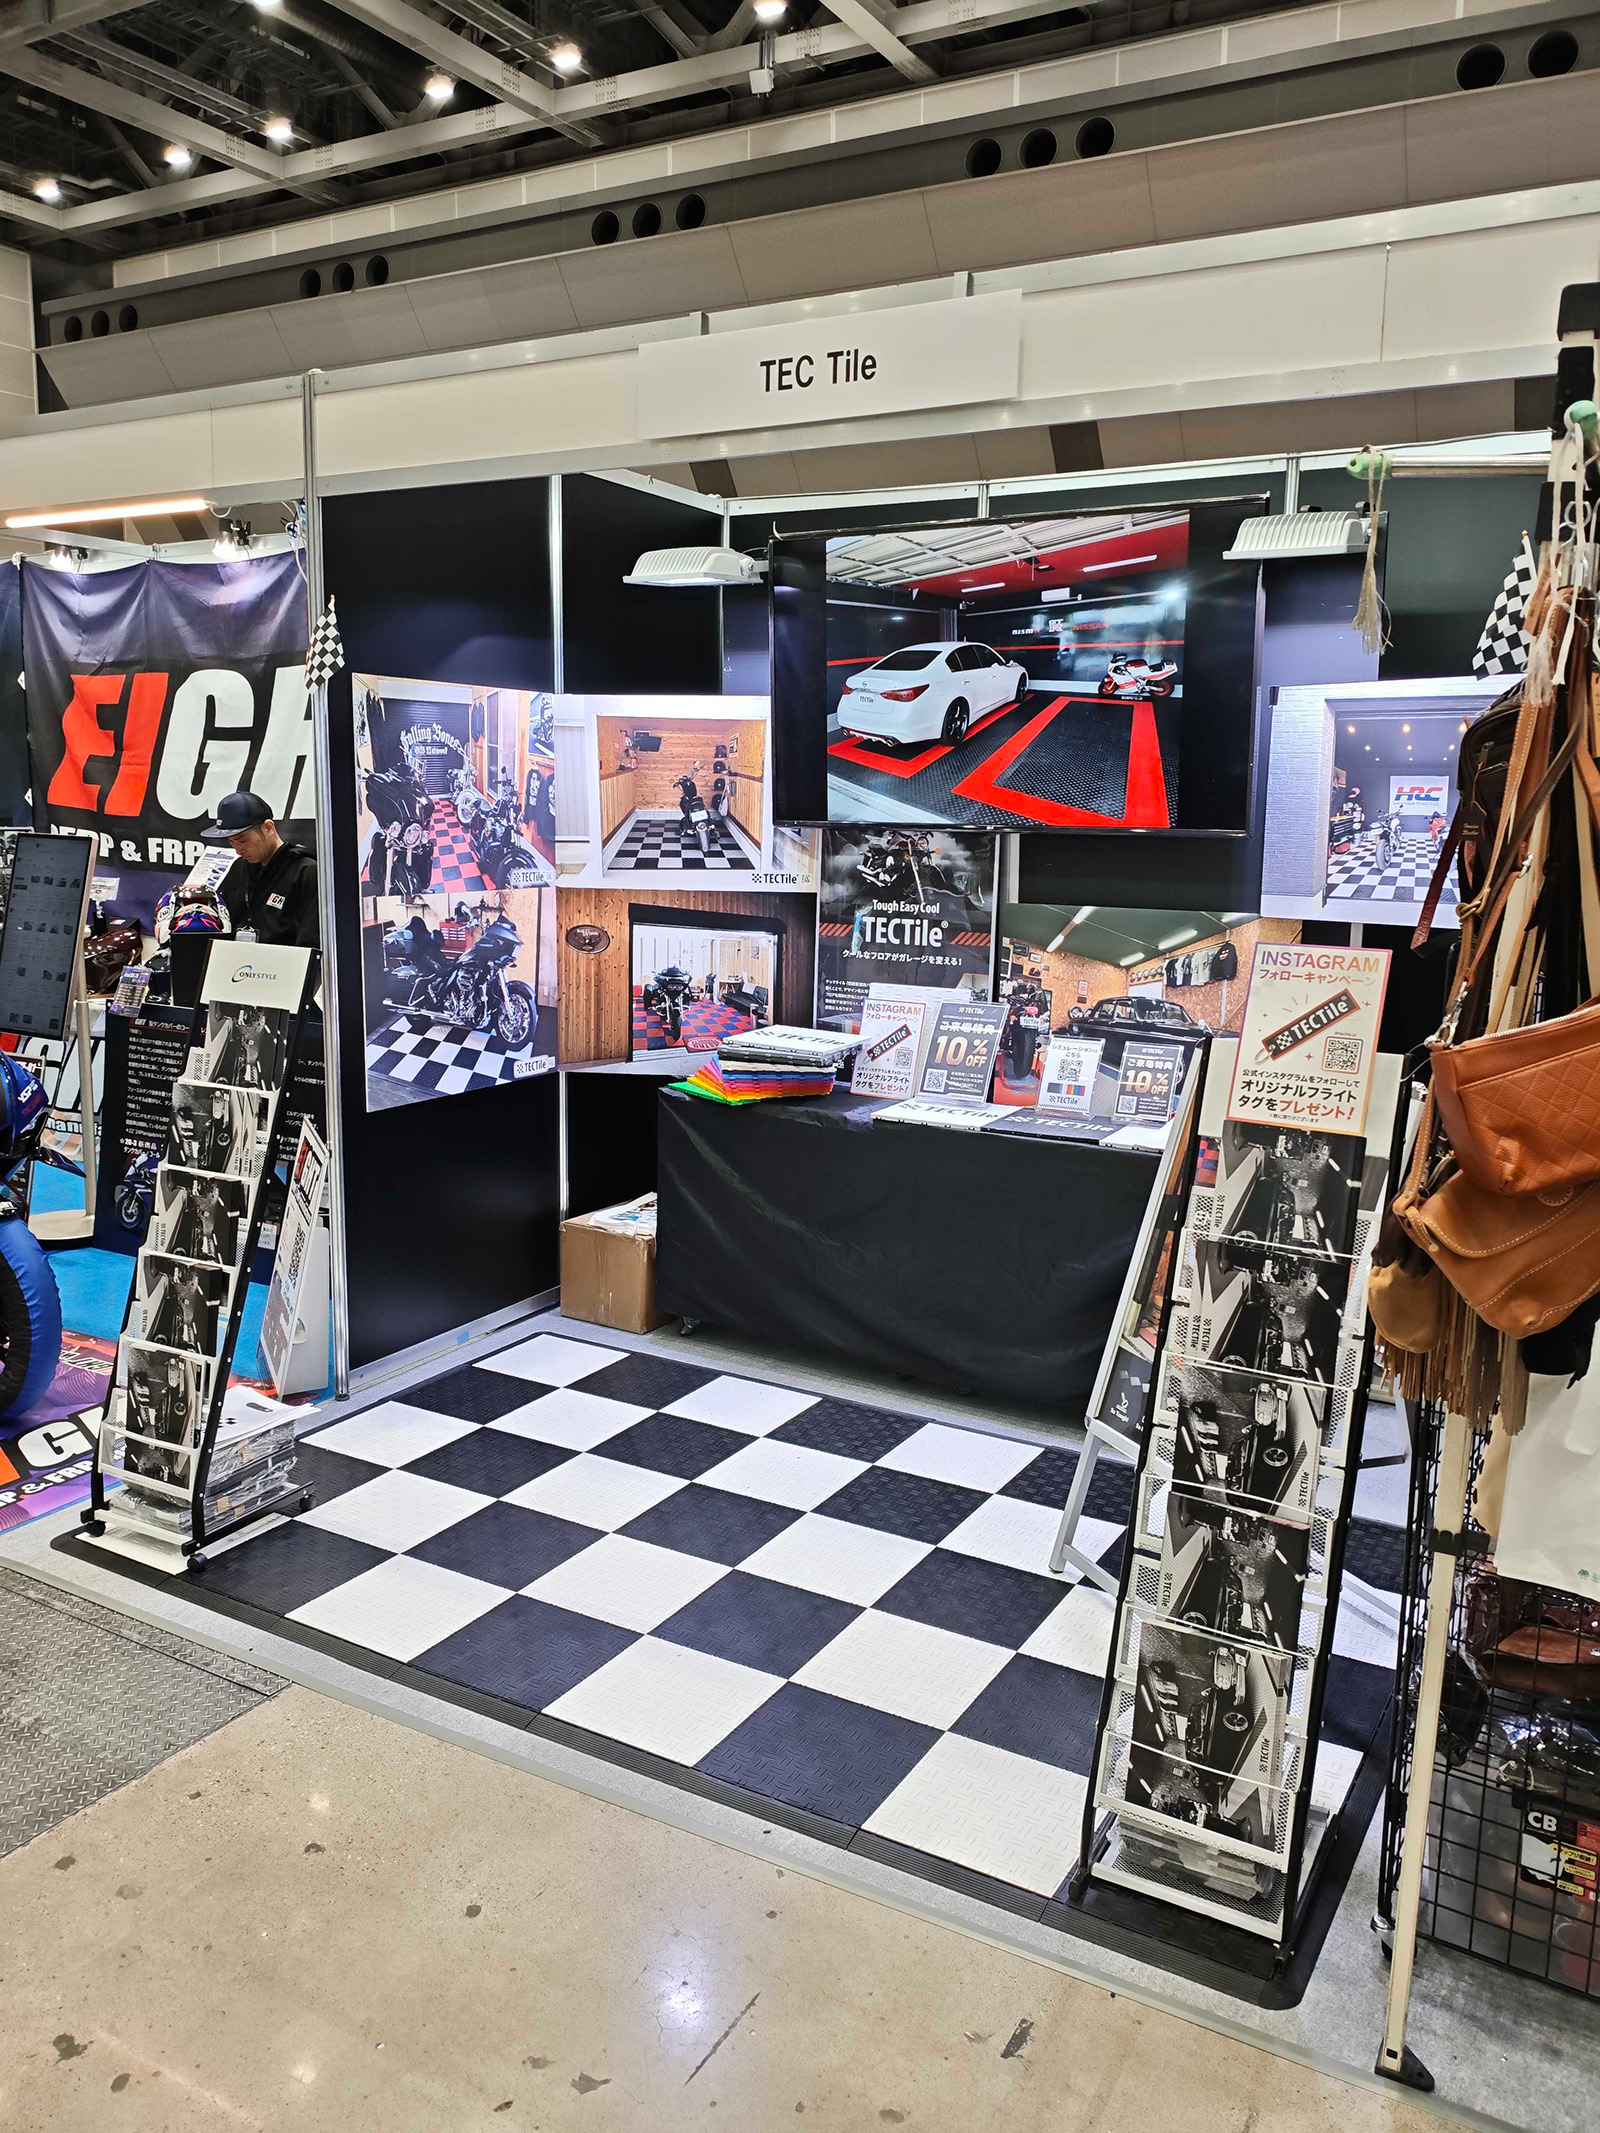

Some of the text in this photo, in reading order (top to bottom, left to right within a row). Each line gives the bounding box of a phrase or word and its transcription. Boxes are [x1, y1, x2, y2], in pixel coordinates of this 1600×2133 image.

[760, 348, 877, 393] TEC Tile
[1394, 786, 1443, 801] HRC
[521, 872, 544, 883] TECTile
[763, 873, 797, 884] TECTile
[873, 899, 940, 915] Tough Easy Cool
[1261, 950, 1380, 973] INSTAGRAM
[1259, 969, 1376, 987] フォローキャンペーン
[866, 1002, 922, 1016] INSTAGRAM
[965, 1054, 988, 1068] OFF
[856, 1071, 910, 1085] オリジナルフライト
[1242, 1068, 1361, 1089] 公式インスタグラムをフォローして
[1150, 1084, 1169, 1096] OFF
[1241, 1079, 1358, 1104] オリジナルフライト
[1056, 1095, 1079, 1105] TECTile
[924, 1105, 999, 1119] TECTile
[1033, 1118, 1115, 1132] TECTile
[1213, 1203, 1225, 1228] TECTile
[1200, 1327, 1211, 1352] TECTile
[1299, 1471, 1310, 1497] TECTile
[1161, 1582, 1172, 1608] TECTile
[1260, 1738, 1271, 1764] TECTile
[1527, 1811, 1558, 1832] CB
